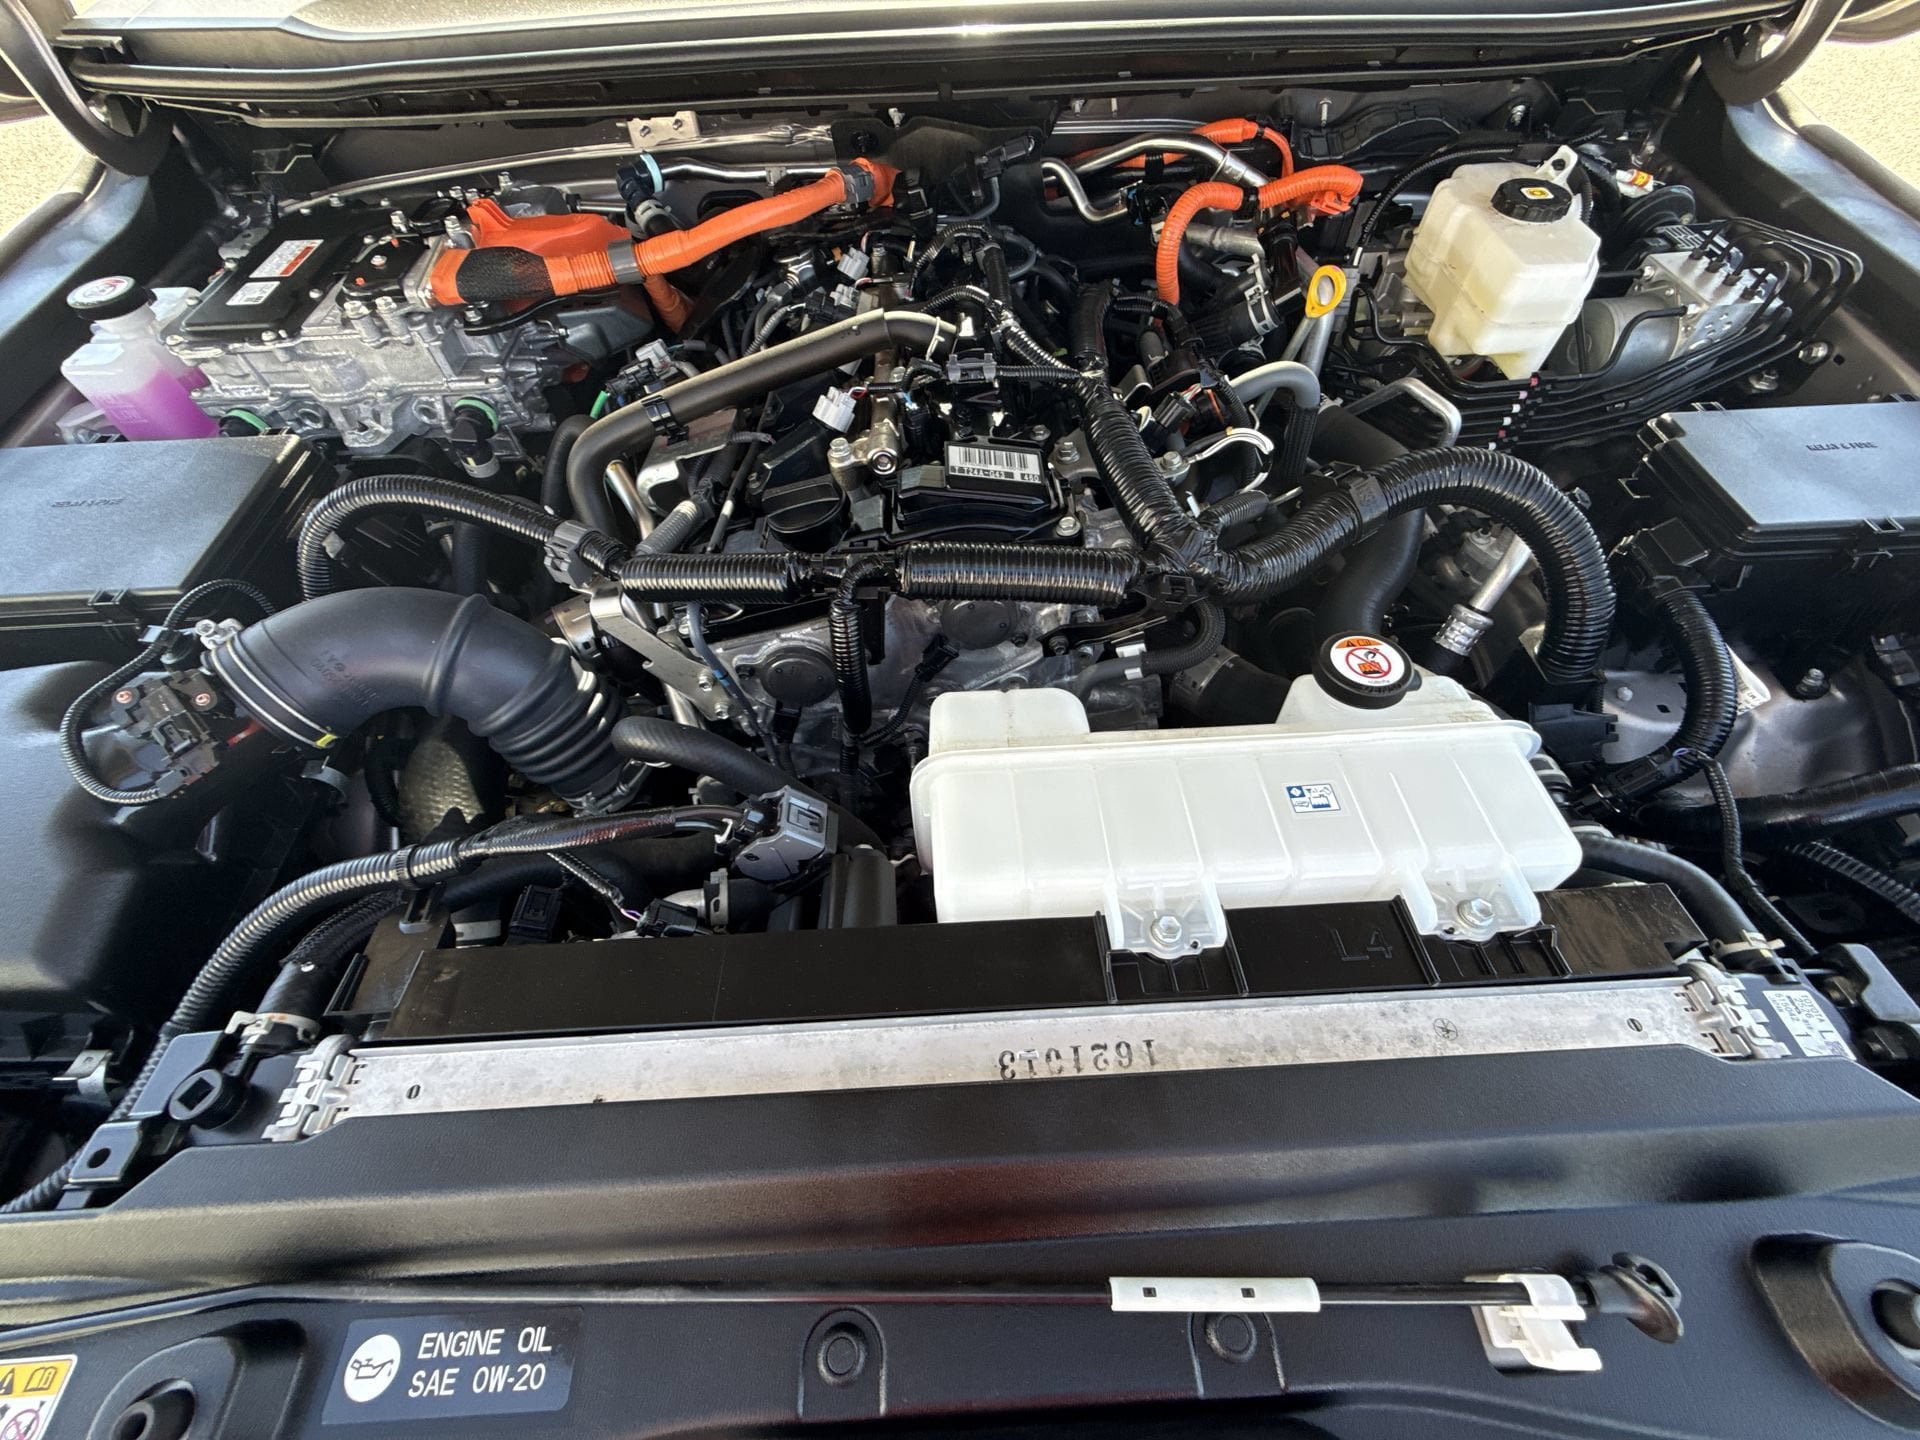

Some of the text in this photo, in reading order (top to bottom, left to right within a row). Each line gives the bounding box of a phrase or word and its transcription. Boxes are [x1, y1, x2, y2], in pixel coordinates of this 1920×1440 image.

[1801, 995, 1826, 1023] TOYOTA
[417, 1326, 553, 1360] ENGINE OIL
[408, 1363, 547, 1398] SAE 0W-20
